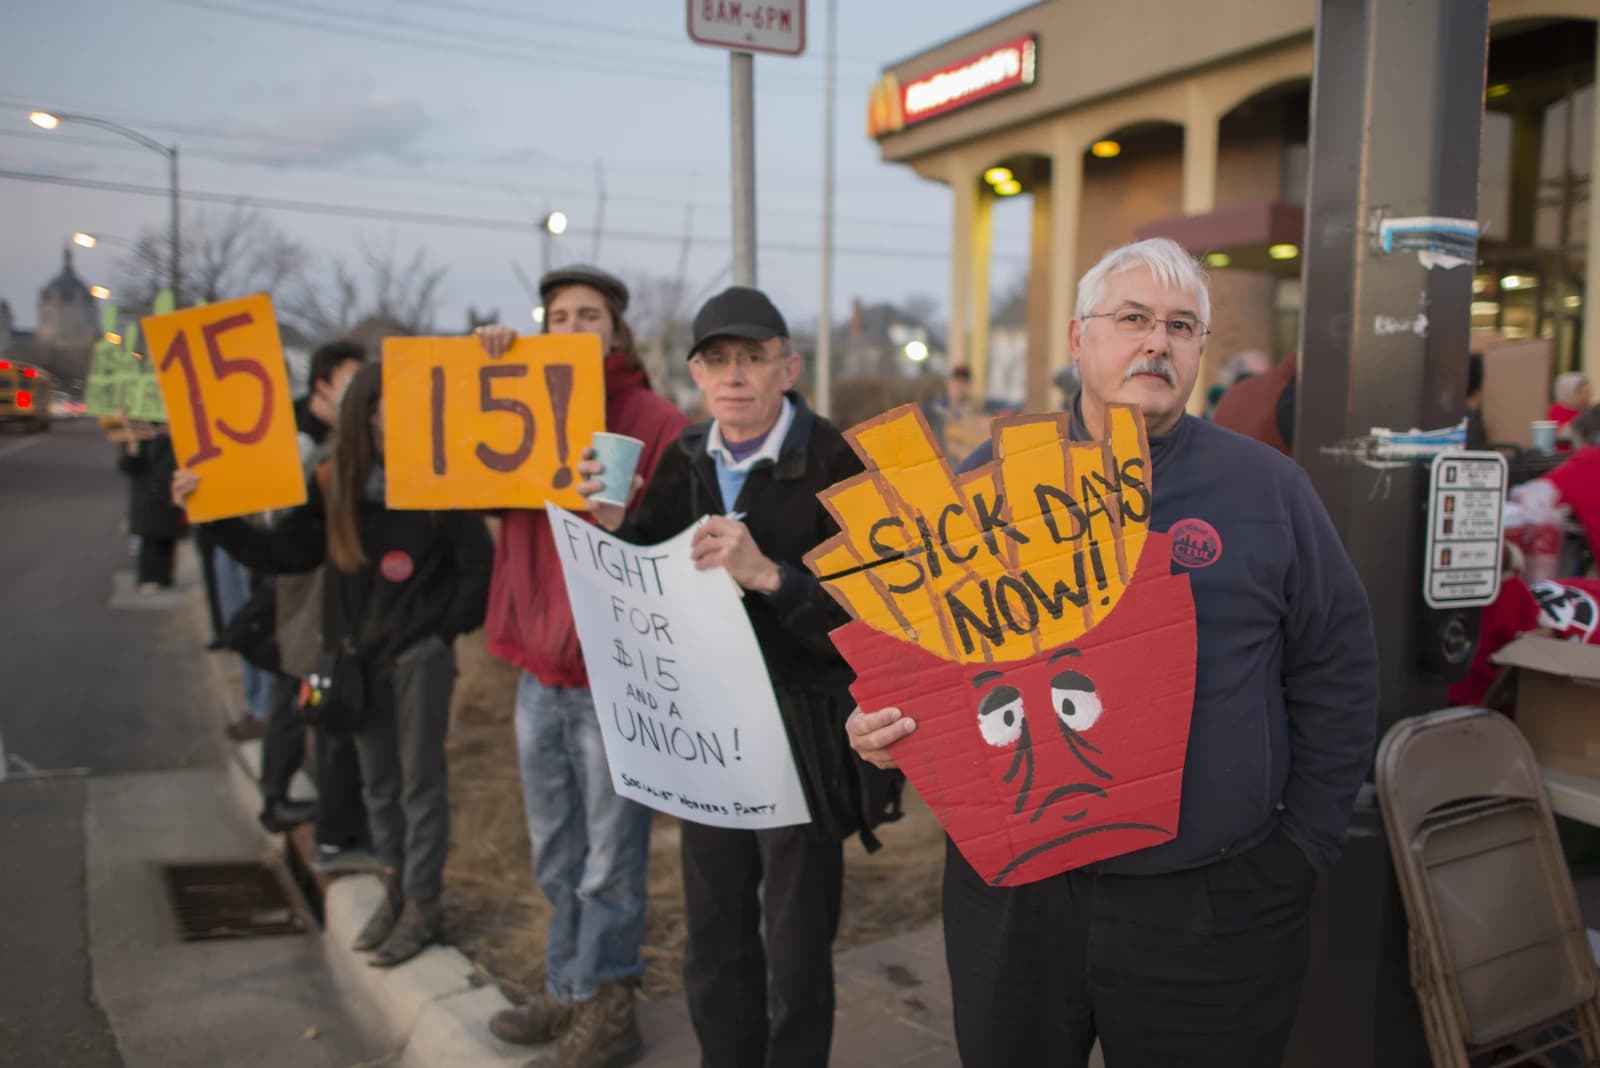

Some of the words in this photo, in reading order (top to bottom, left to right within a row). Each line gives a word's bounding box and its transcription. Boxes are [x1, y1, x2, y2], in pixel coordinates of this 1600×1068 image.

[160, 312, 276, 469] 15
[430, 363, 574, 490] 15!
[563, 518, 670, 596] FIGHT
[869, 492, 1031, 595] SICK
[1033, 456, 1151, 544] DAYS
[610, 594, 674, 645] FOR
[946, 539, 1111, 655] NOW!
[611, 638, 681, 692] $15
[626, 682, 658, 711] AND
[668, 701, 683, 720] A
[620, 772, 674, 801] SOCIALIST
[678, 792, 729, 816] WORKERS
[733, 801, 777, 817] PARTY
